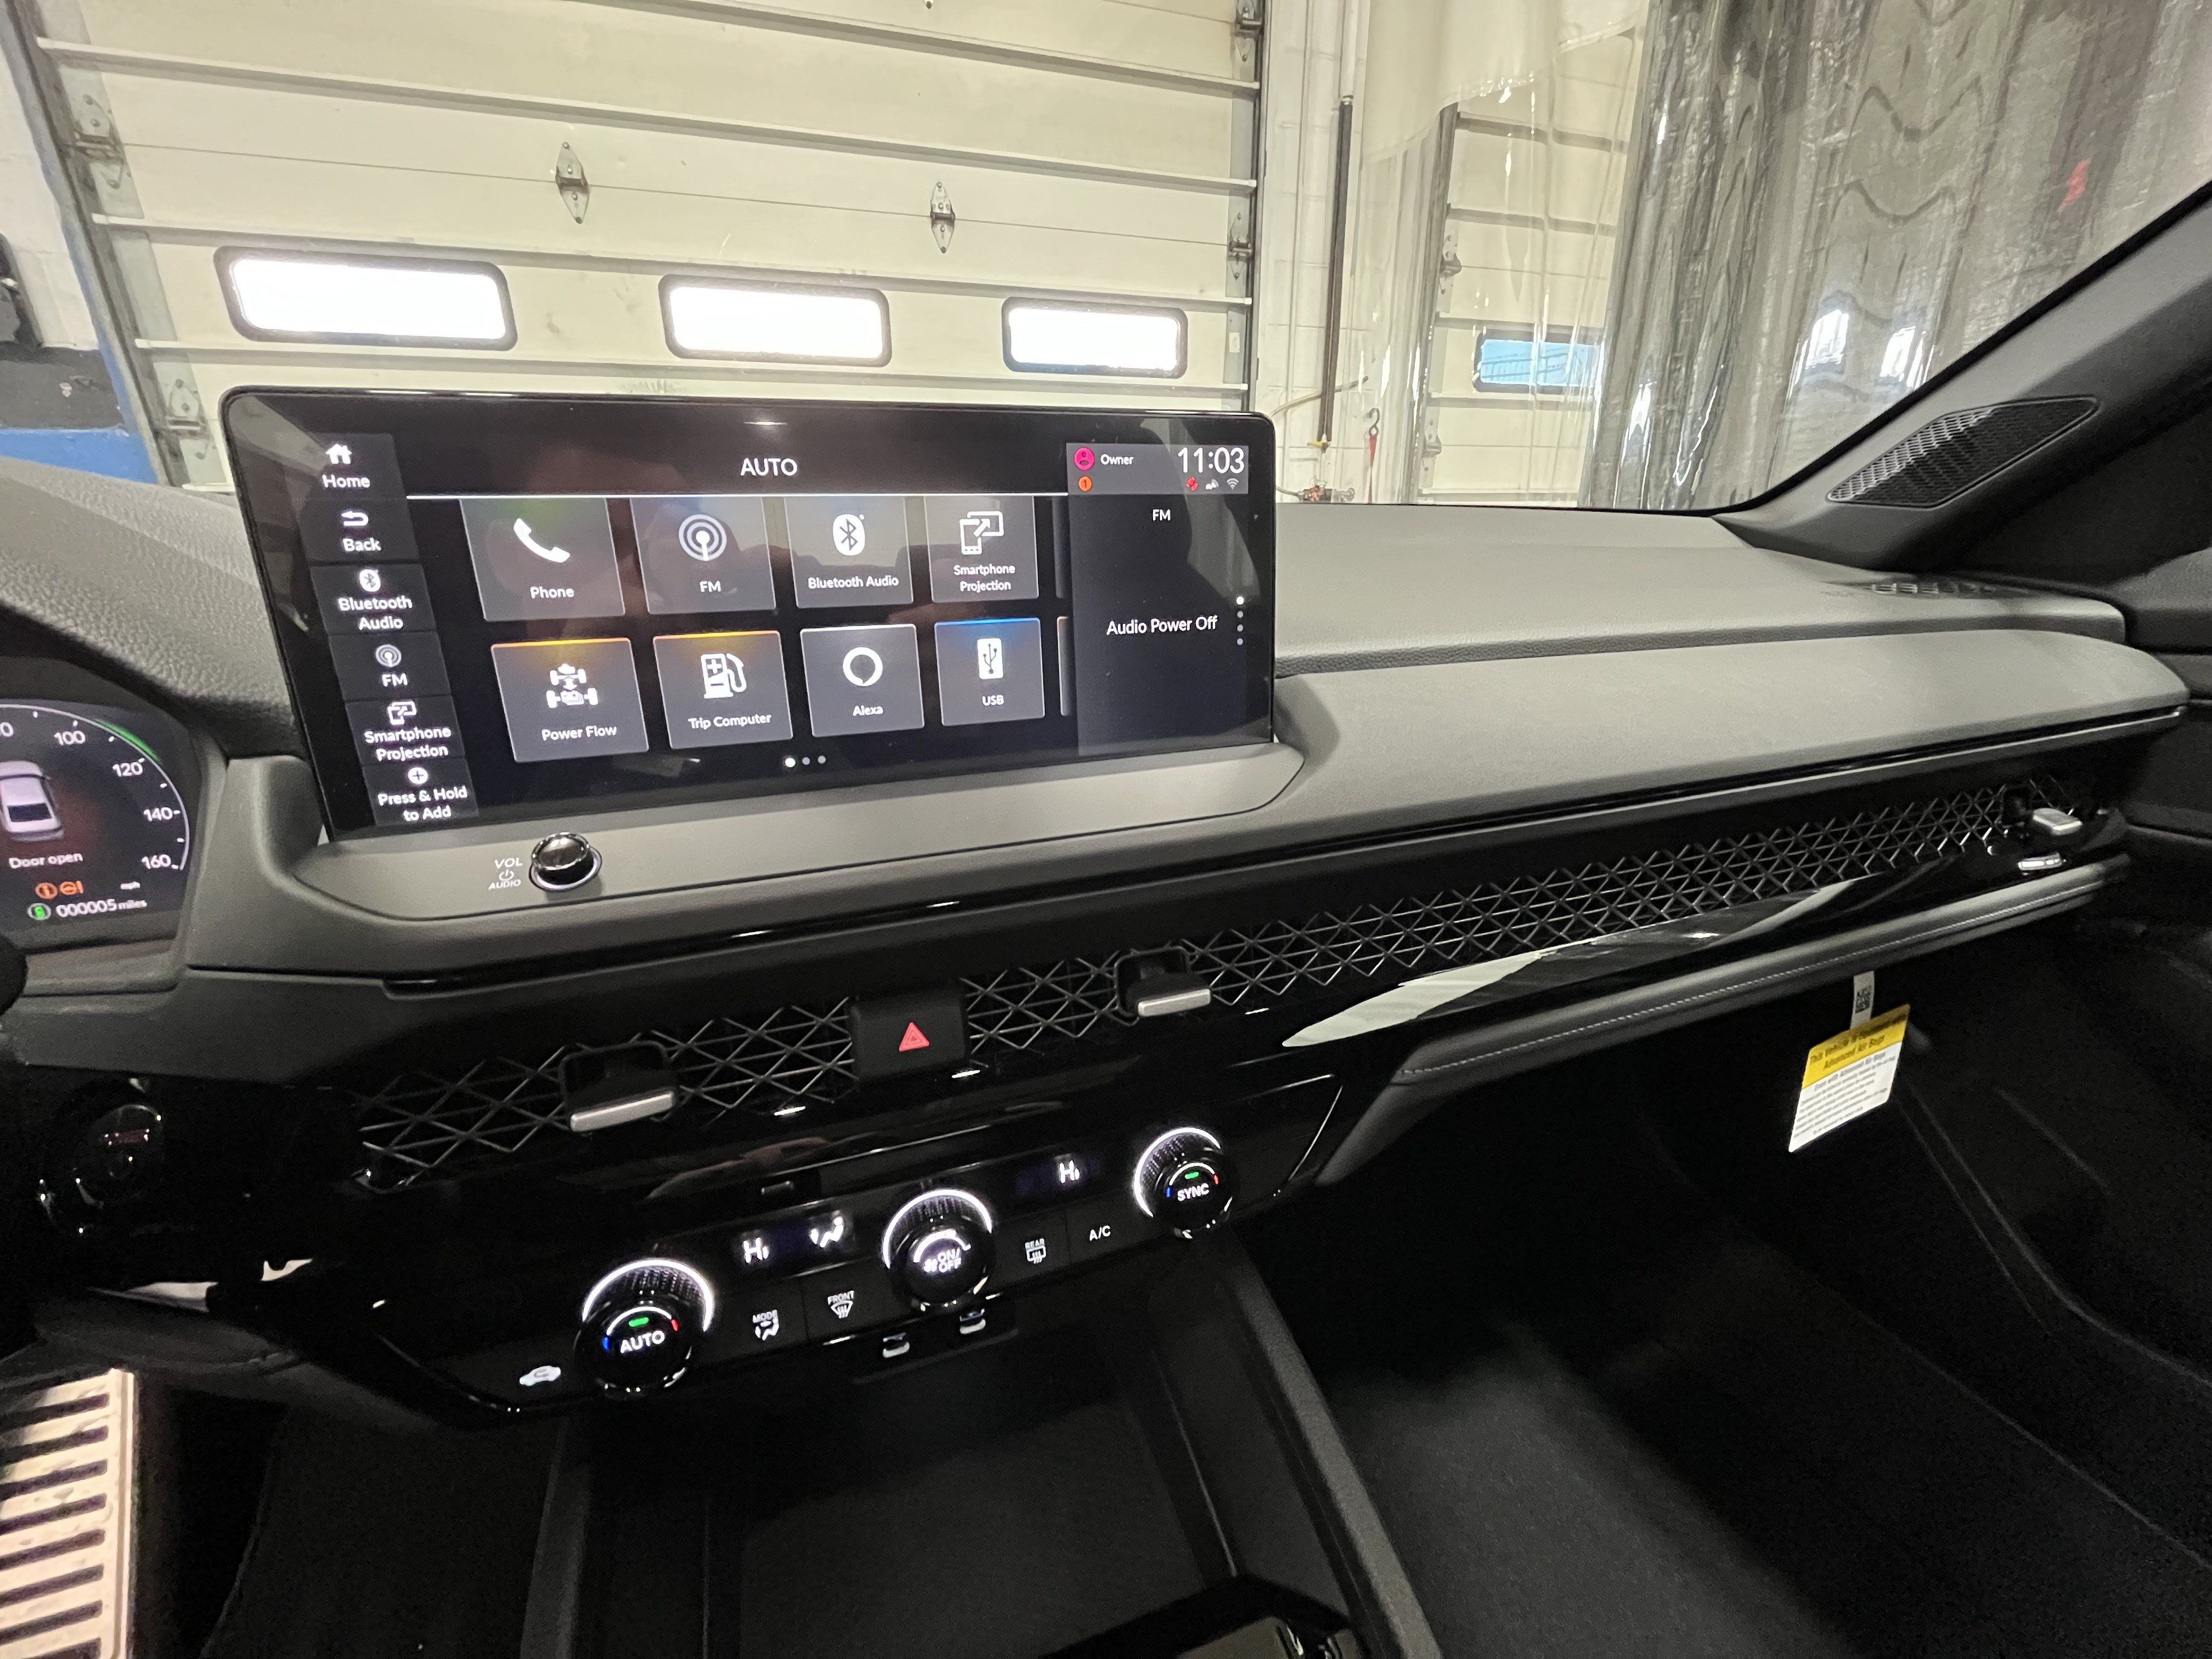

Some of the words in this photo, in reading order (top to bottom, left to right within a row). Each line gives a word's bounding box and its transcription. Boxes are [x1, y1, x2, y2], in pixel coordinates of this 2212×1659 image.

[740, 458, 798, 476] AUTO
[1101, 454, 1133, 465] Owner
[1178, 447, 1245, 473] 11:03
[323, 475, 370, 489] Home
[1152, 510, 1171, 521] FM
[343, 537, 381, 551] Back
[953, 564, 1015, 577] Smartphone
[700, 581, 721, 593] FM
[808, 577, 864, 589] Bluetooth
[866, 575, 899, 587] Audio
[960, 580, 1011, 592] Projection
[530, 586, 574, 599] Phone
[338, 595, 413, 611] Bluetooth
[358, 617, 404, 630] Audio
[1107, 620, 1147, 635] Audio
[1151, 618, 1192, 633] Power
[1195, 616, 1218, 630] Off
[382, 674, 408, 687] FM
[982, 695, 1005, 706] USB
[853, 704, 884, 716] Alexa
[0, 722, 14, 737] 0
[688, 718, 711, 730] Trip
[713, 714, 771, 729] Computer
[54, 731, 86, 746] 100
[364, 727, 452, 744] Smartphone
[541, 727, 583, 741] Power
[586, 724, 617, 738] Flow
[376, 744, 448, 760] Projection
[112, 762, 143, 777] 120
[377, 792, 415, 806] Press
[419, 790, 432, 802] &
[433, 785, 468, 801] Hold
[143, 807, 172, 822] 140
[403, 809, 420, 822] to
[422, 805, 452, 820] Add
[9, 856, 44, 868] Door
[48, 853, 83, 864] open
[142, 854, 172, 869] 160
[494, 857, 523, 869] VOL
[488, 879, 521, 890] AUDIO
[56, 899, 117, 917] 000005
[1177, 1183, 1209, 1201] SYNC
[1089, 1225, 1111, 1241] A/C
[1025, 1238, 1045, 1250] REAR
[828, 1290, 854, 1303] FRONT
[753, 1310, 777, 1324] MODE
[620, 1330, 665, 1353] AUTO
